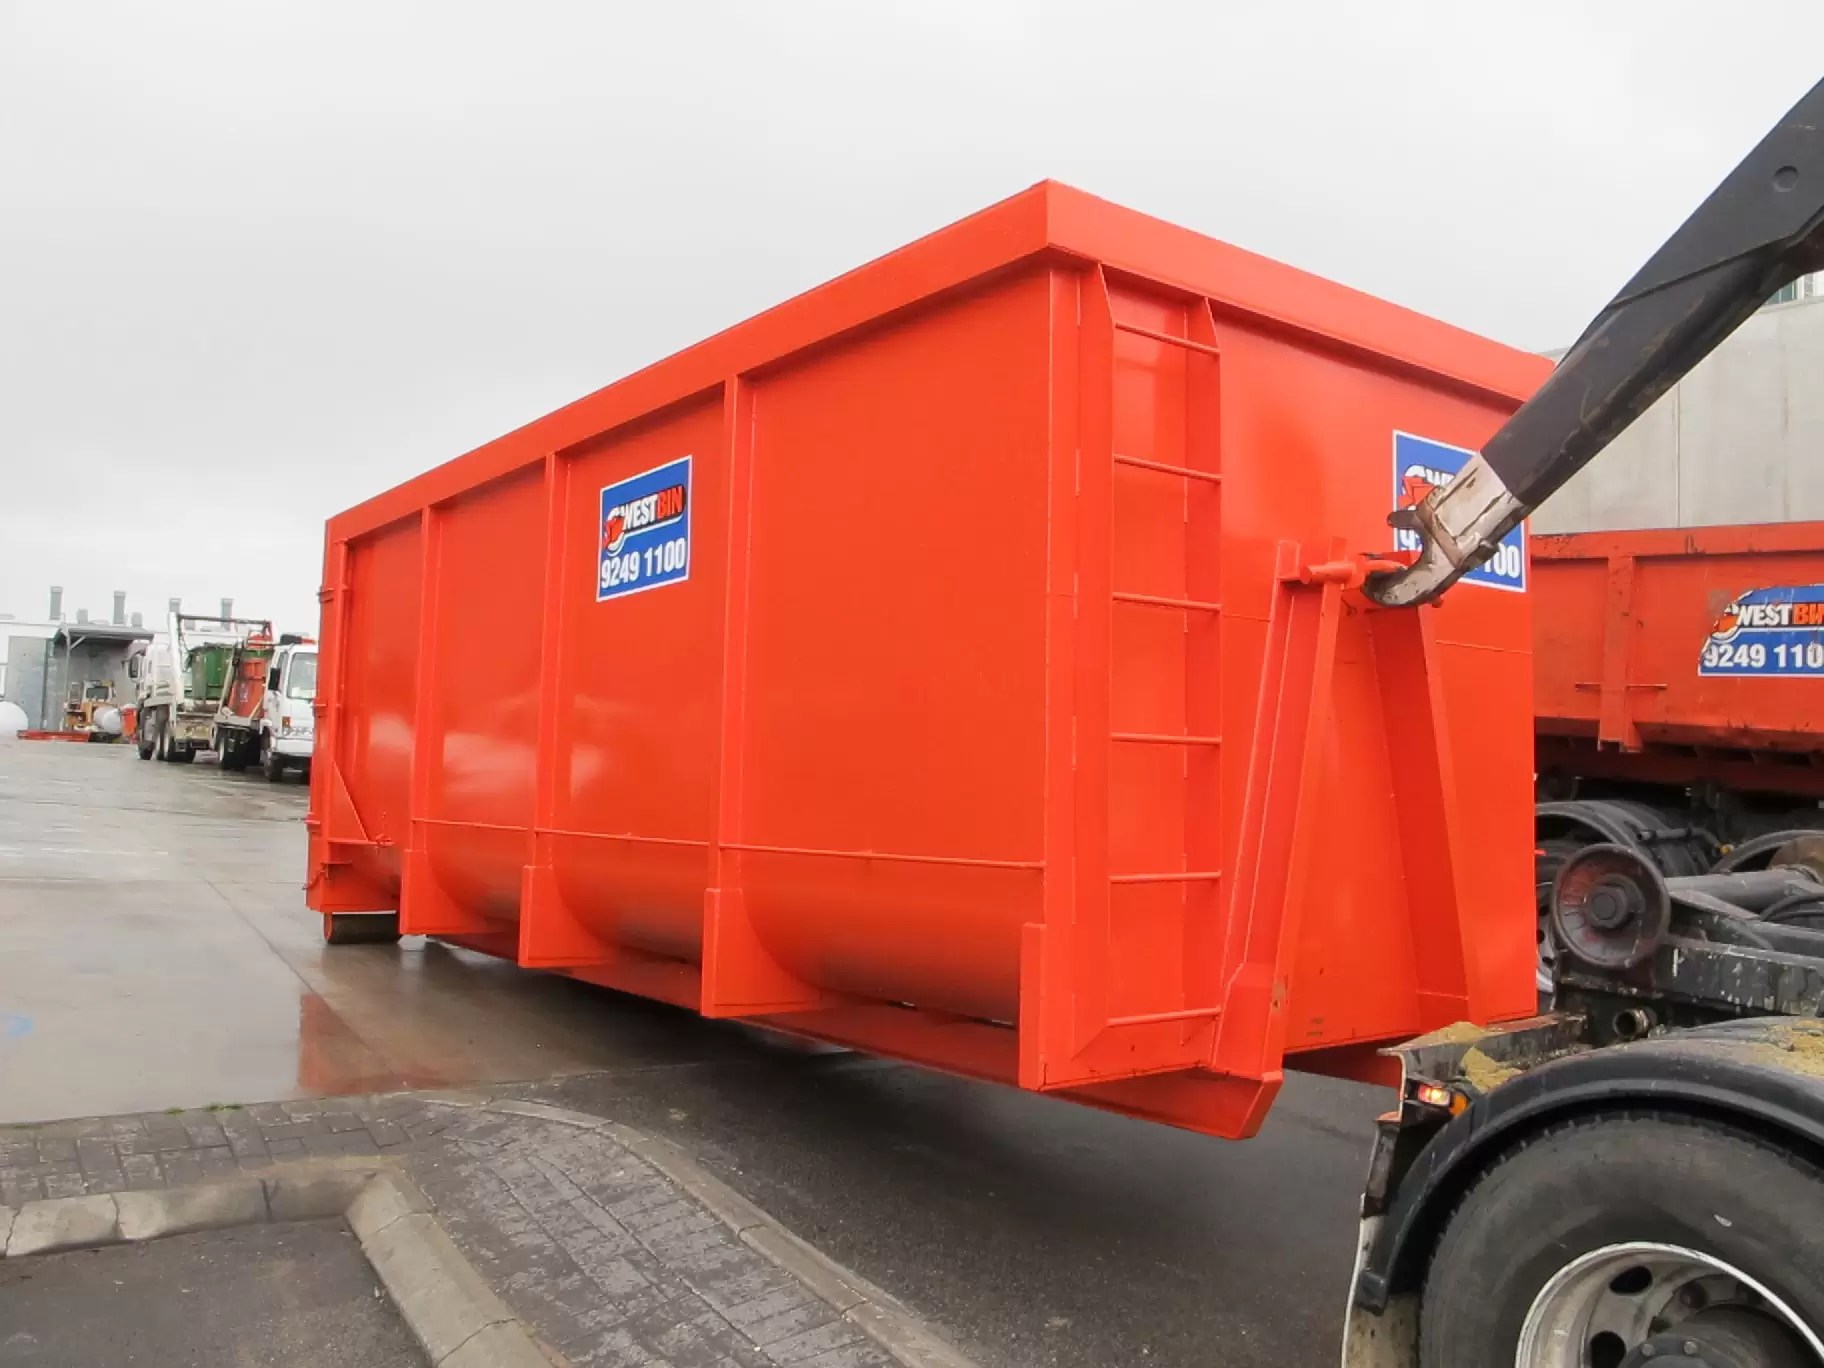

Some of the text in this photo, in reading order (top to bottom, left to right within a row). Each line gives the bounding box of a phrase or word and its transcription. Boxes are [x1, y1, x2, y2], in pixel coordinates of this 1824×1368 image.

[619, 486, 683, 531] WESTBIN
[601, 537, 686, 589] 9249 1100
[1703, 643, 1766, 668] 9249
